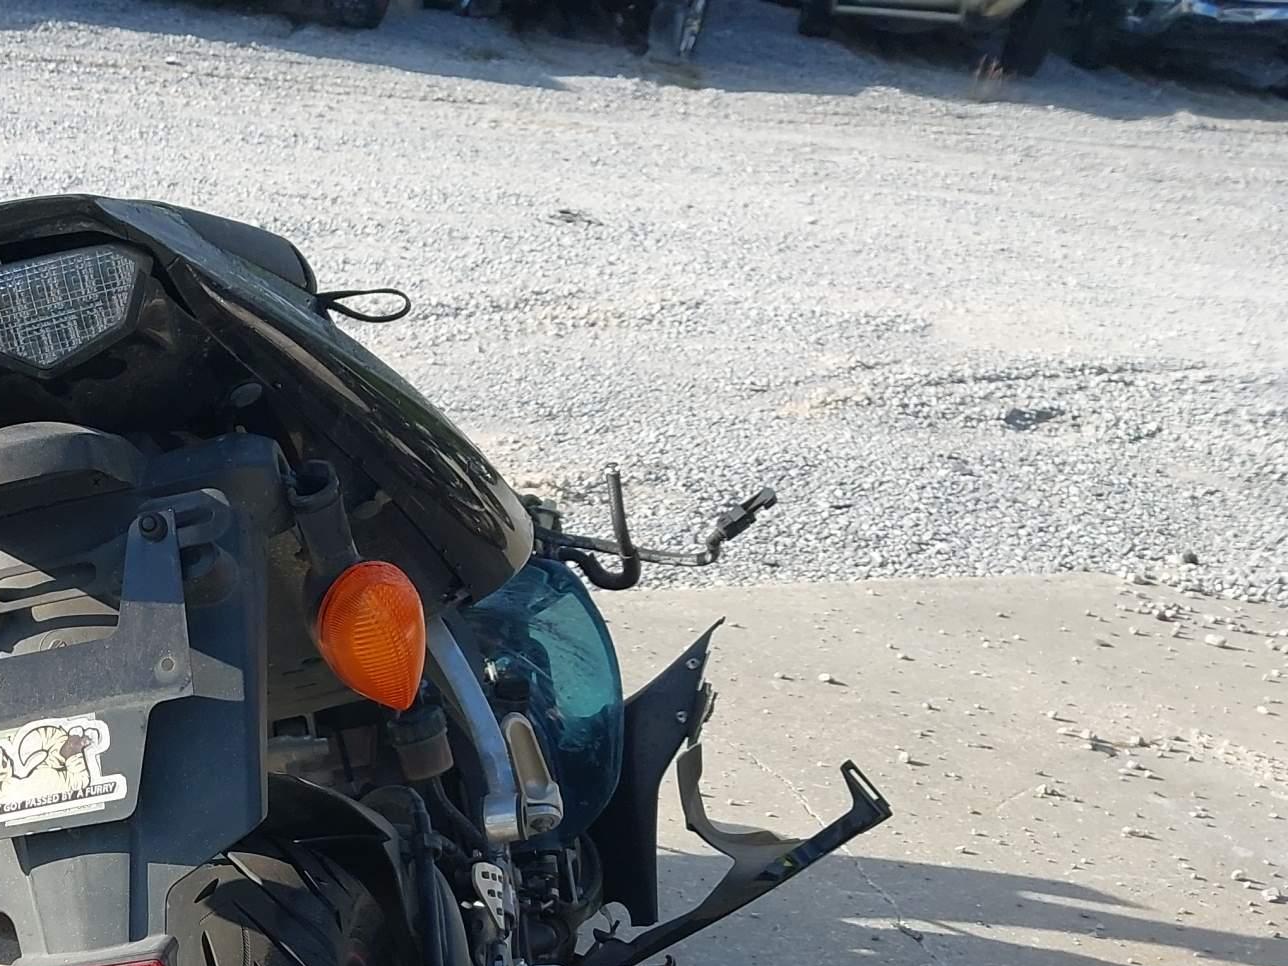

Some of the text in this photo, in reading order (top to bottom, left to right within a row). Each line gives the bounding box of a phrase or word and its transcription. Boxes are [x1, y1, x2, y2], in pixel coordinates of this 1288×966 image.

[3, 800, 21, 812] GOT
[25, 793, 59, 808] PASSED
[61, 790, 73, 800] BY
[76, 789, 84, 799] A
[85, 782, 115, 797] FURRY
